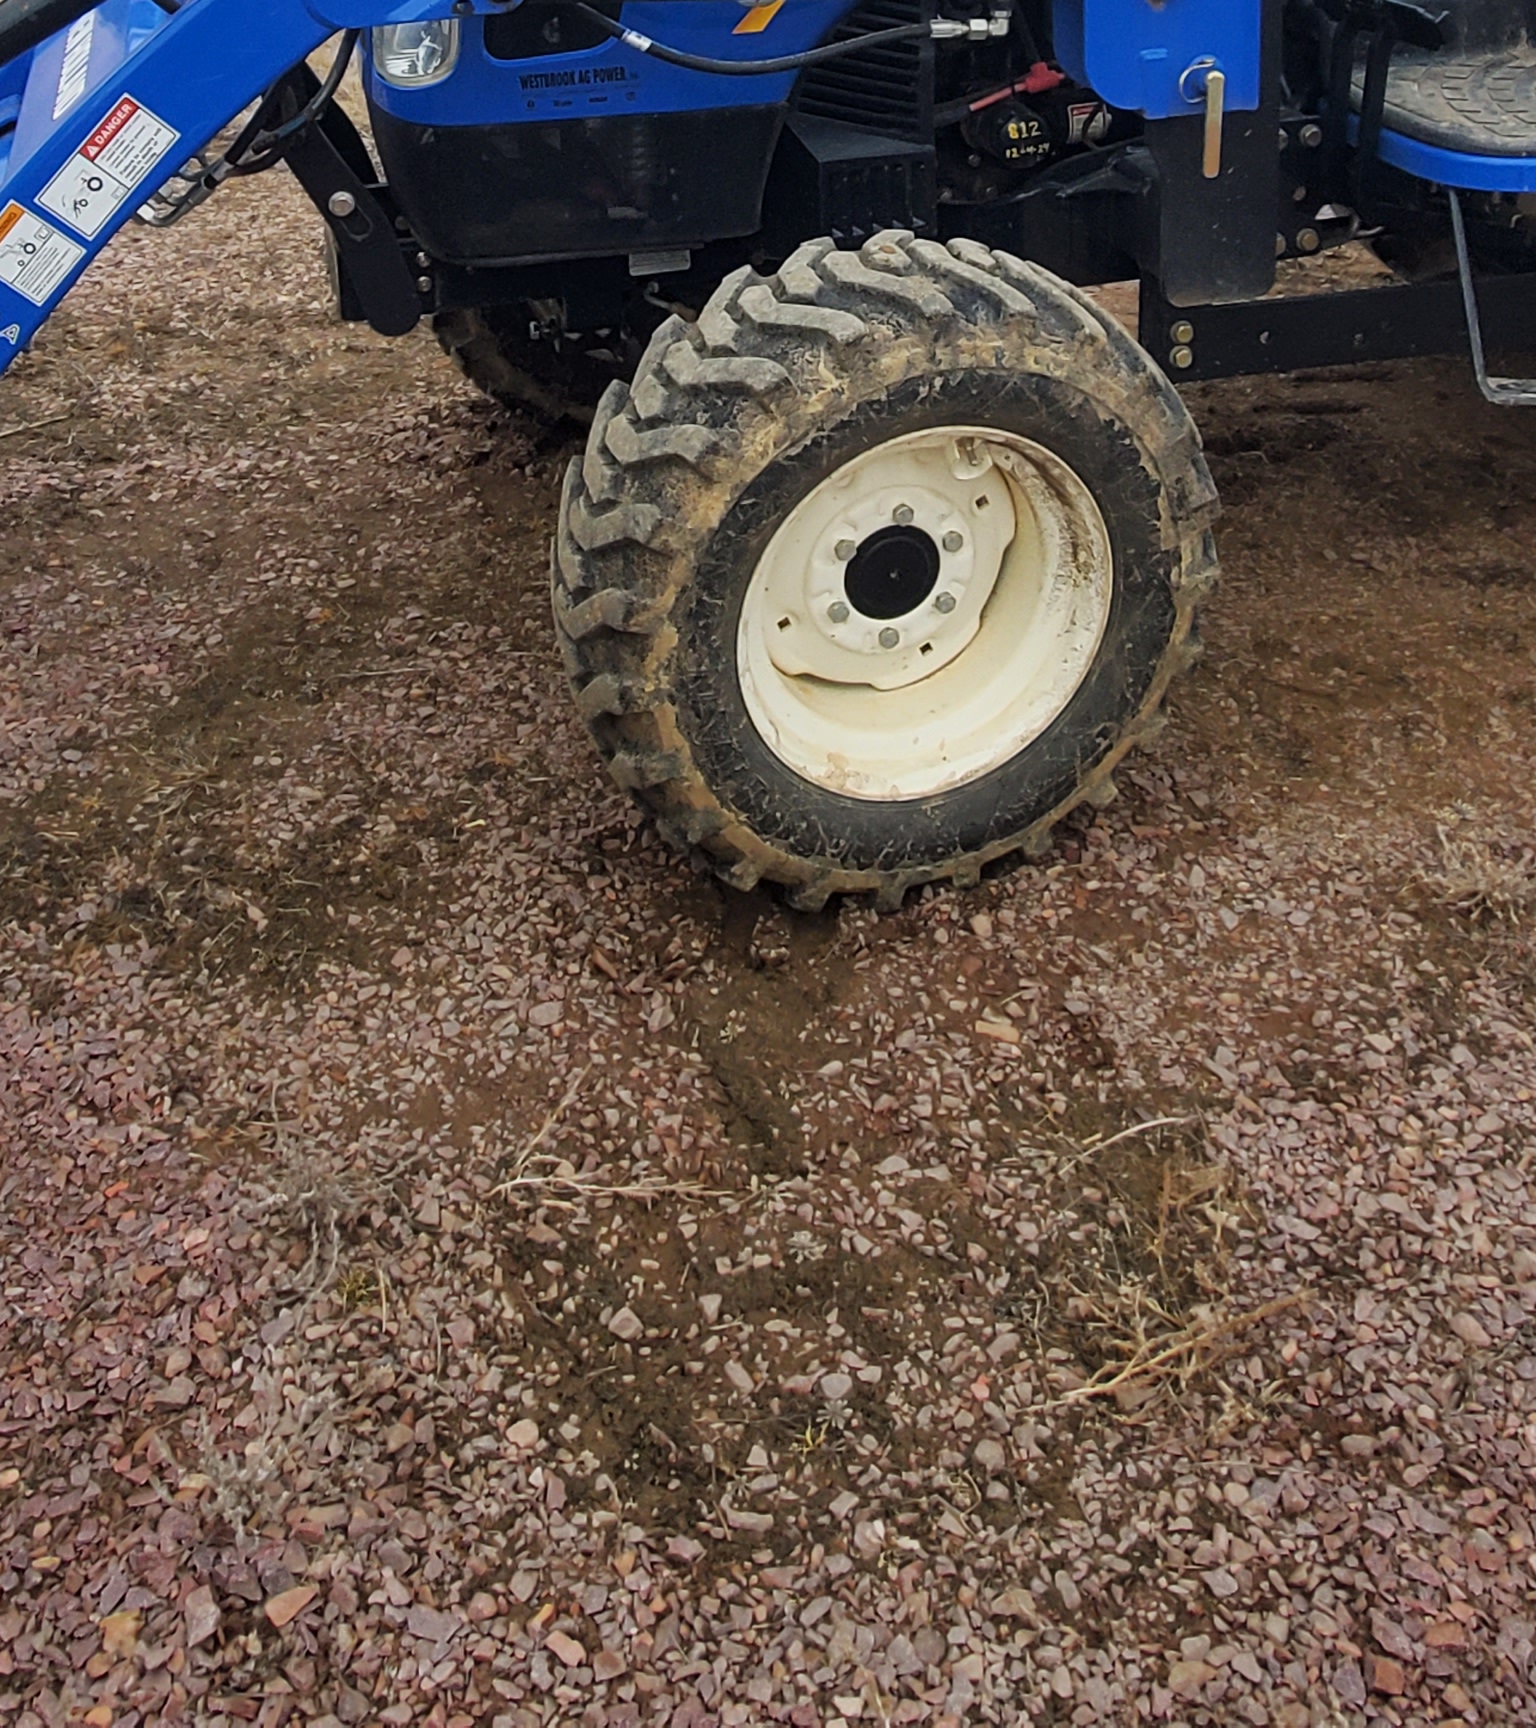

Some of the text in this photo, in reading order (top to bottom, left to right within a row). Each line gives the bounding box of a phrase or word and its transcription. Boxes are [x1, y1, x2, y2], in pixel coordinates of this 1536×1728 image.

[593, 66, 626, 84] POWER
[95, 103, 133, 146] DANGER
[1007, 121, 1042, 140] 812
